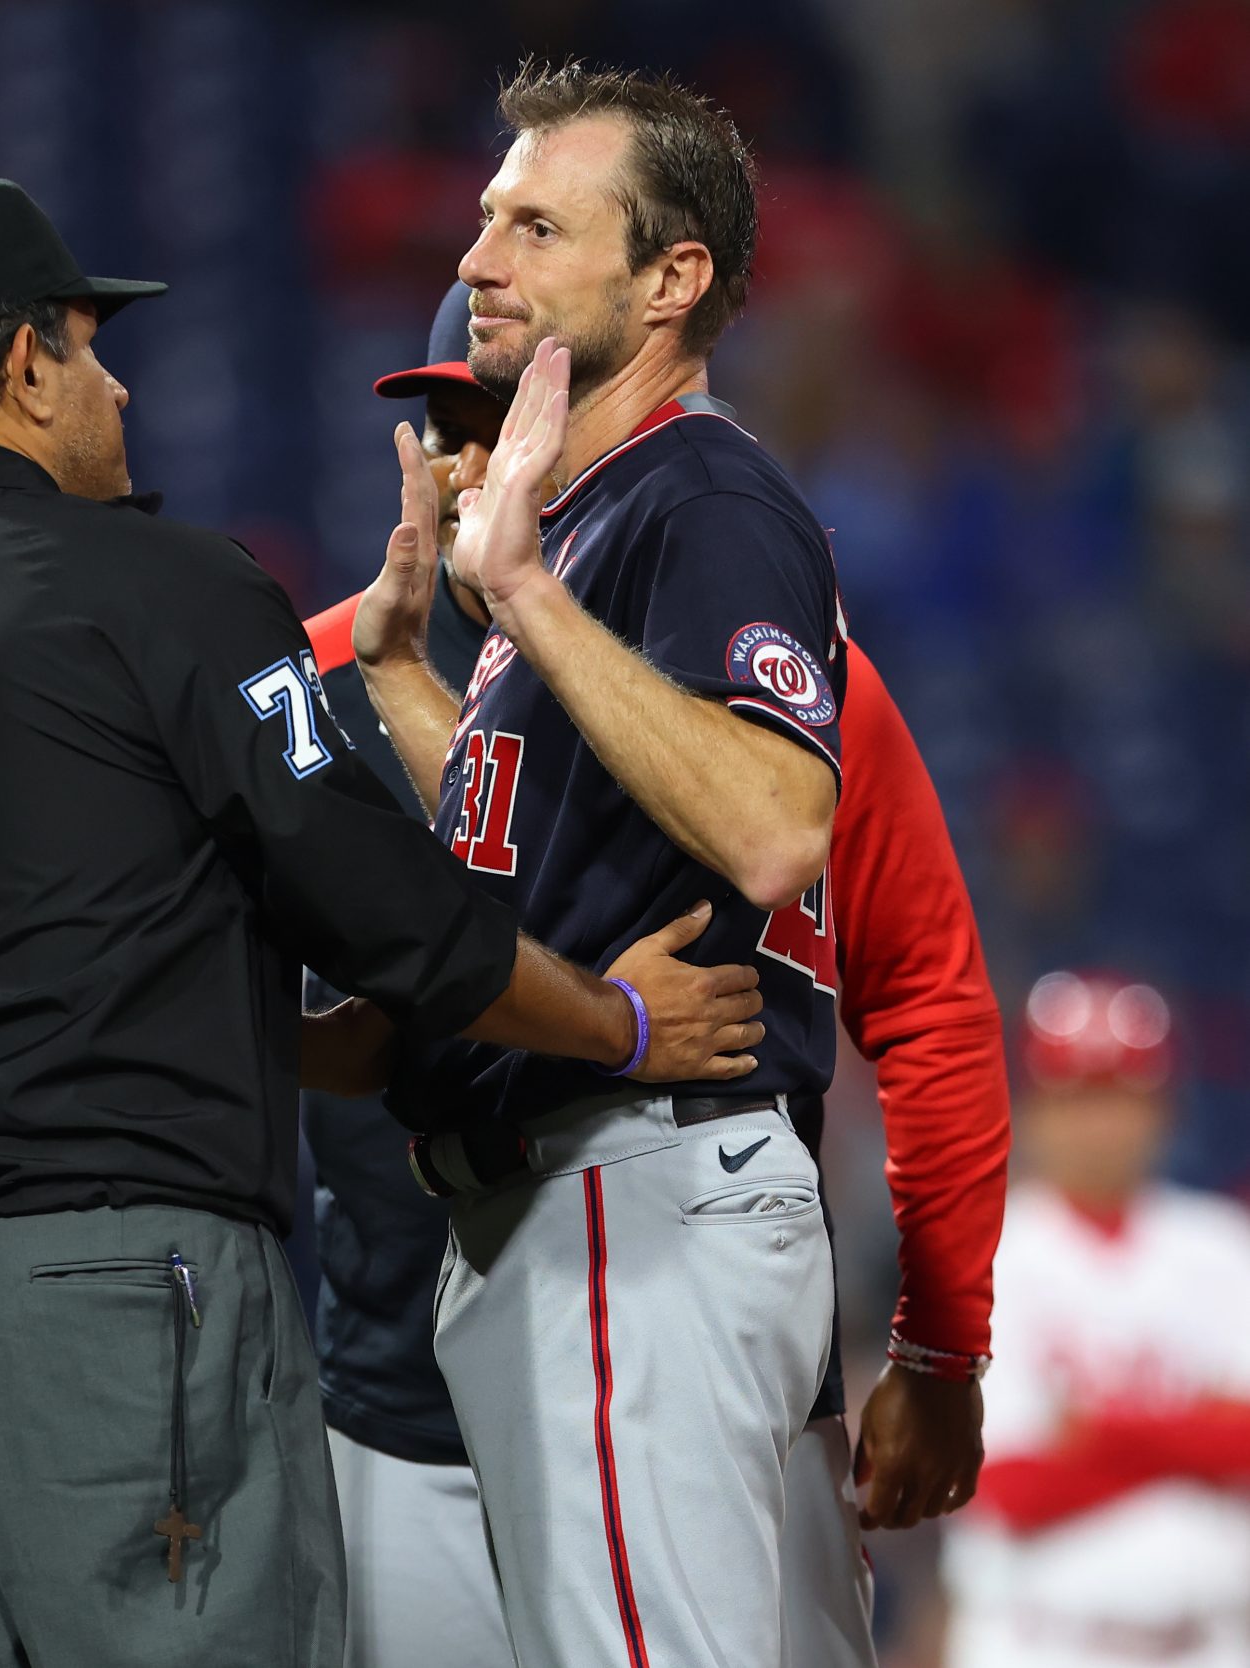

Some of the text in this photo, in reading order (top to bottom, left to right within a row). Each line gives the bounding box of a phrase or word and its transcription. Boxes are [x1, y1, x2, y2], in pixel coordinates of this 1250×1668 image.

[733, 627, 822, 675] WASHINGTON
[789, 698, 833, 721] ONALS
[450, 729, 525, 878] 31
